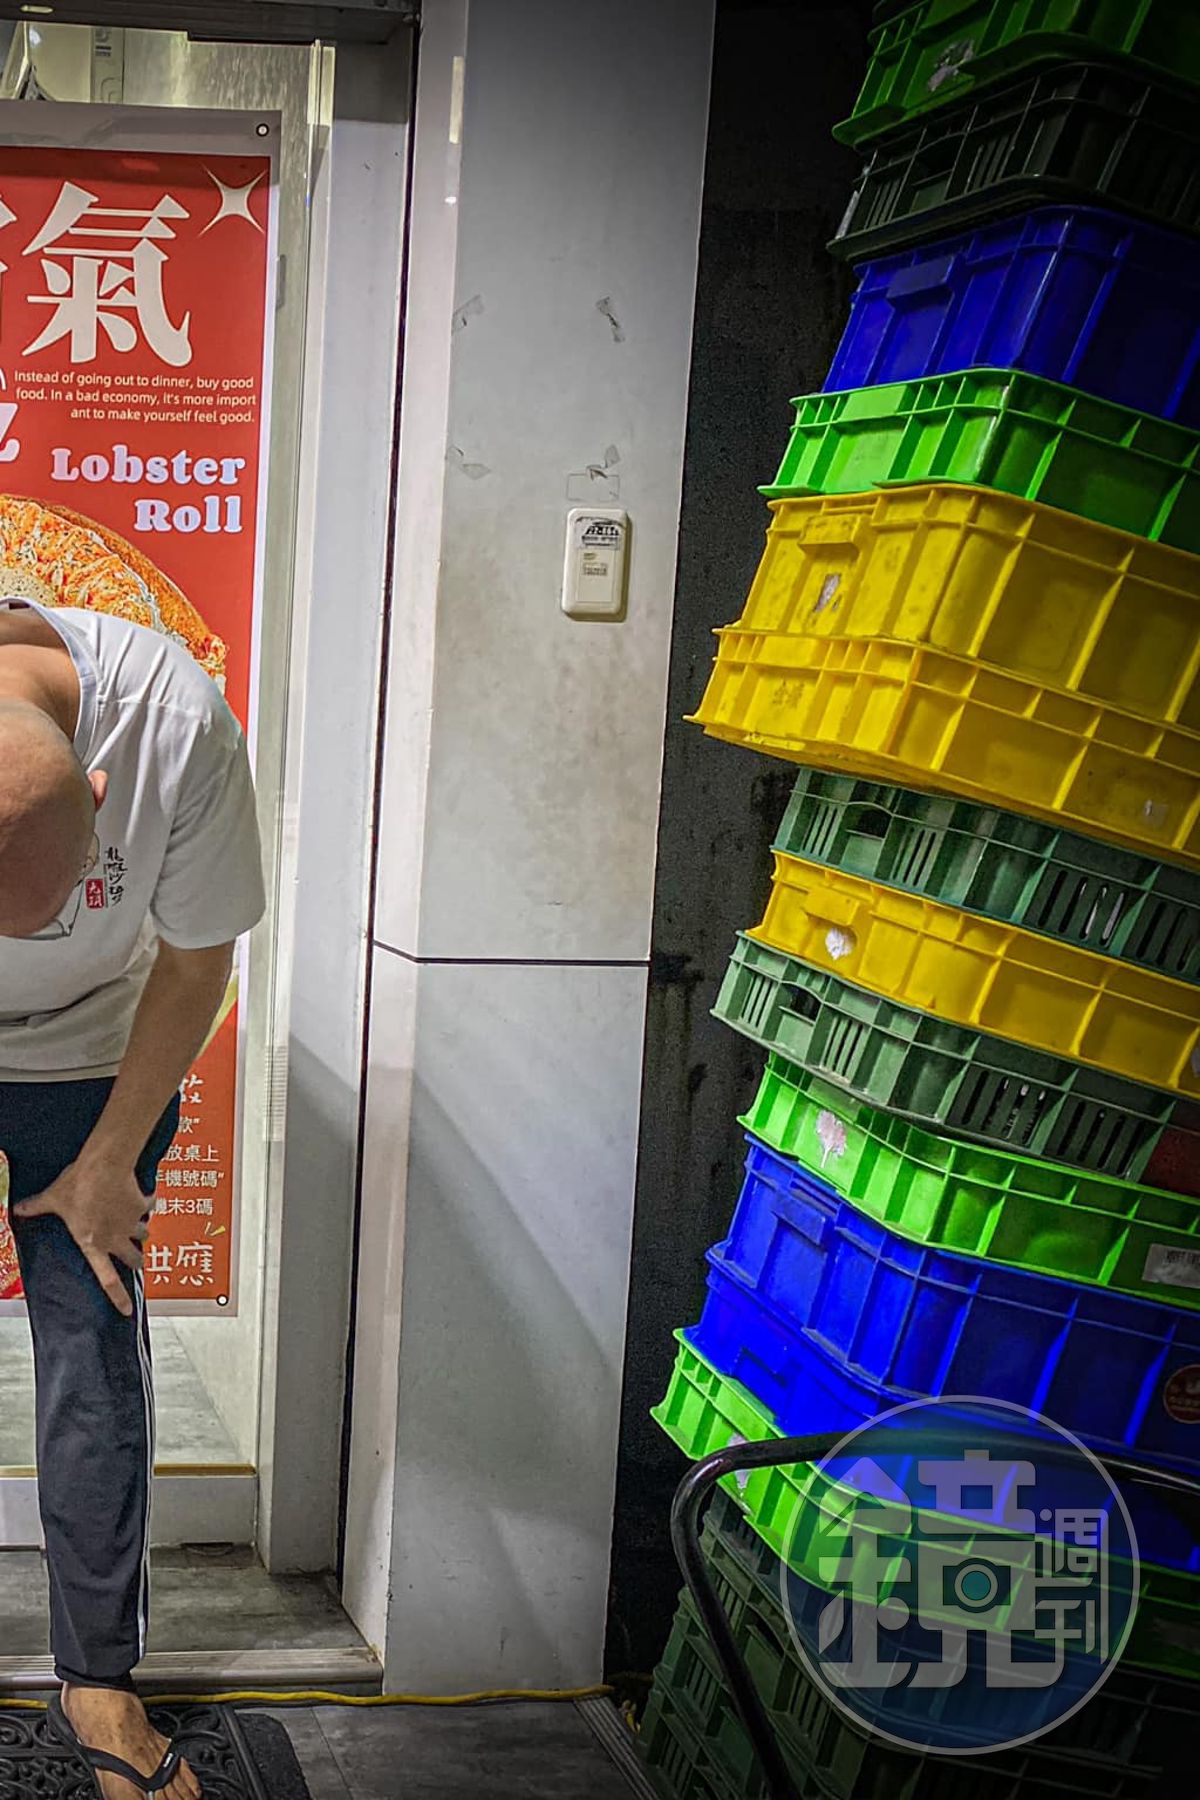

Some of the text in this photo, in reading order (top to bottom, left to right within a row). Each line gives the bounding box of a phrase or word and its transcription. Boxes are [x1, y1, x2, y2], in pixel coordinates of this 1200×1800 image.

[14, 370, 254, 391] Instead of going out to dinner, buy good
[16, 387, 48, 400] food.
[51, 389, 62, 401] In
[65, 391, 73, 401] a
[76, 389, 100, 402] bad
[102, 392, 160, 406] economy,
[182, 395, 214, 405] more
[216, 393, 256, 408] import
[70, 408, 255, 425] ant to make yourself feel good.
[50, 445, 246, 485] Lobster
[134, 495, 242, 533] Roll
